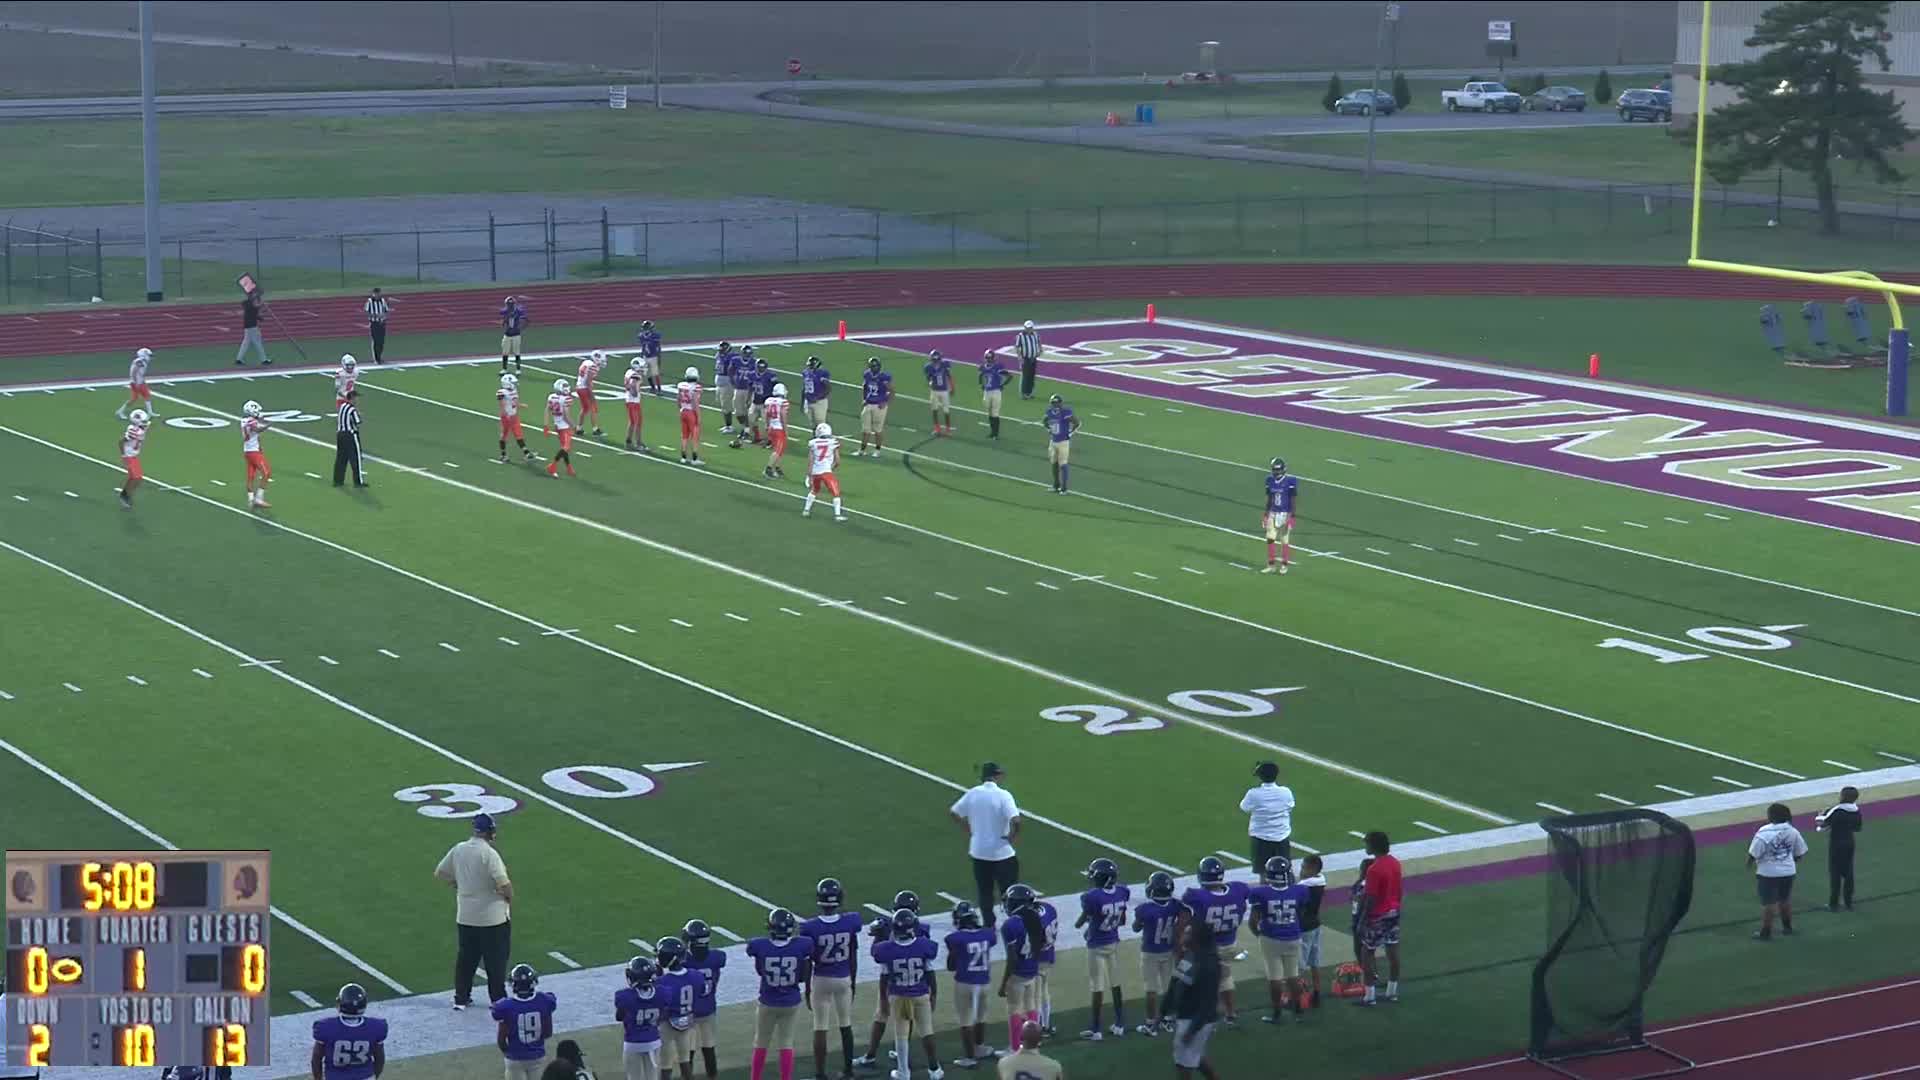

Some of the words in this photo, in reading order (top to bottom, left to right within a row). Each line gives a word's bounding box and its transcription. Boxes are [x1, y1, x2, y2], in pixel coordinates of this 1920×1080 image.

[817, 445, 829, 462] 7
[1274, 493, 1282, 506] 8
[1594, 626, 1793, 664] 10
[1039, 689, 1275, 735] 20
[393, 765, 656, 818] 30
[1267, 900, 1296, 925] 55
[818, 932, 850, 962] 23
[967, 940, 988, 971] 21
[764, 956, 798, 987] 53
[893, 957, 924, 987] 56
[680, 984, 694, 1012] 9
[517, 1011, 542, 1043] 19
[333, 1040, 371, 1067] 63
